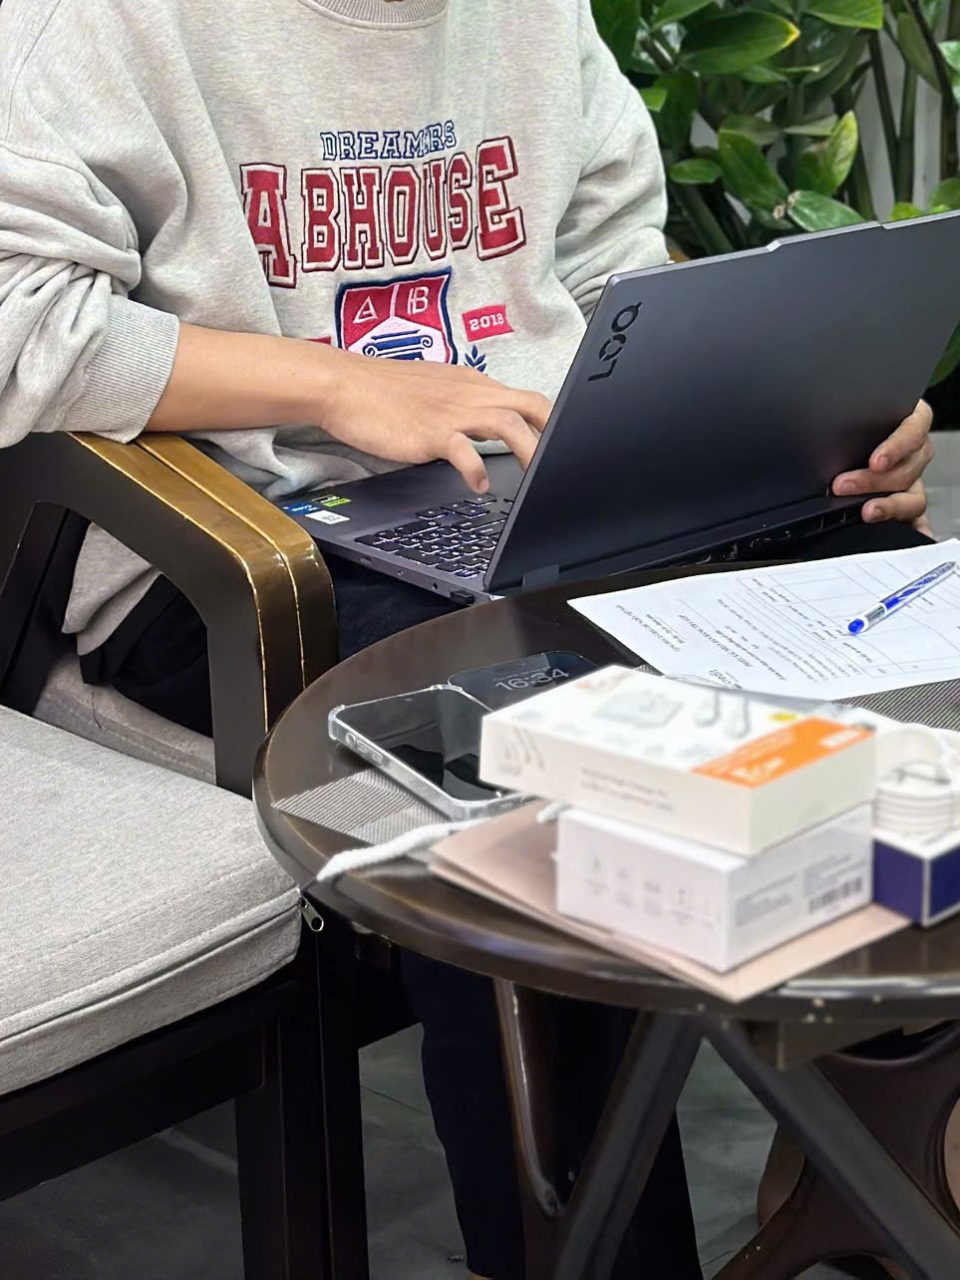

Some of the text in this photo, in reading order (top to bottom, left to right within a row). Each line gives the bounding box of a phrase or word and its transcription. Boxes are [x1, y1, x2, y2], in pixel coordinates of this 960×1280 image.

[239, 136, 528, 289] ABHOUSE
[587, 301, 642, 381] LOQ
[495, 668, 569, 691] 16:34
